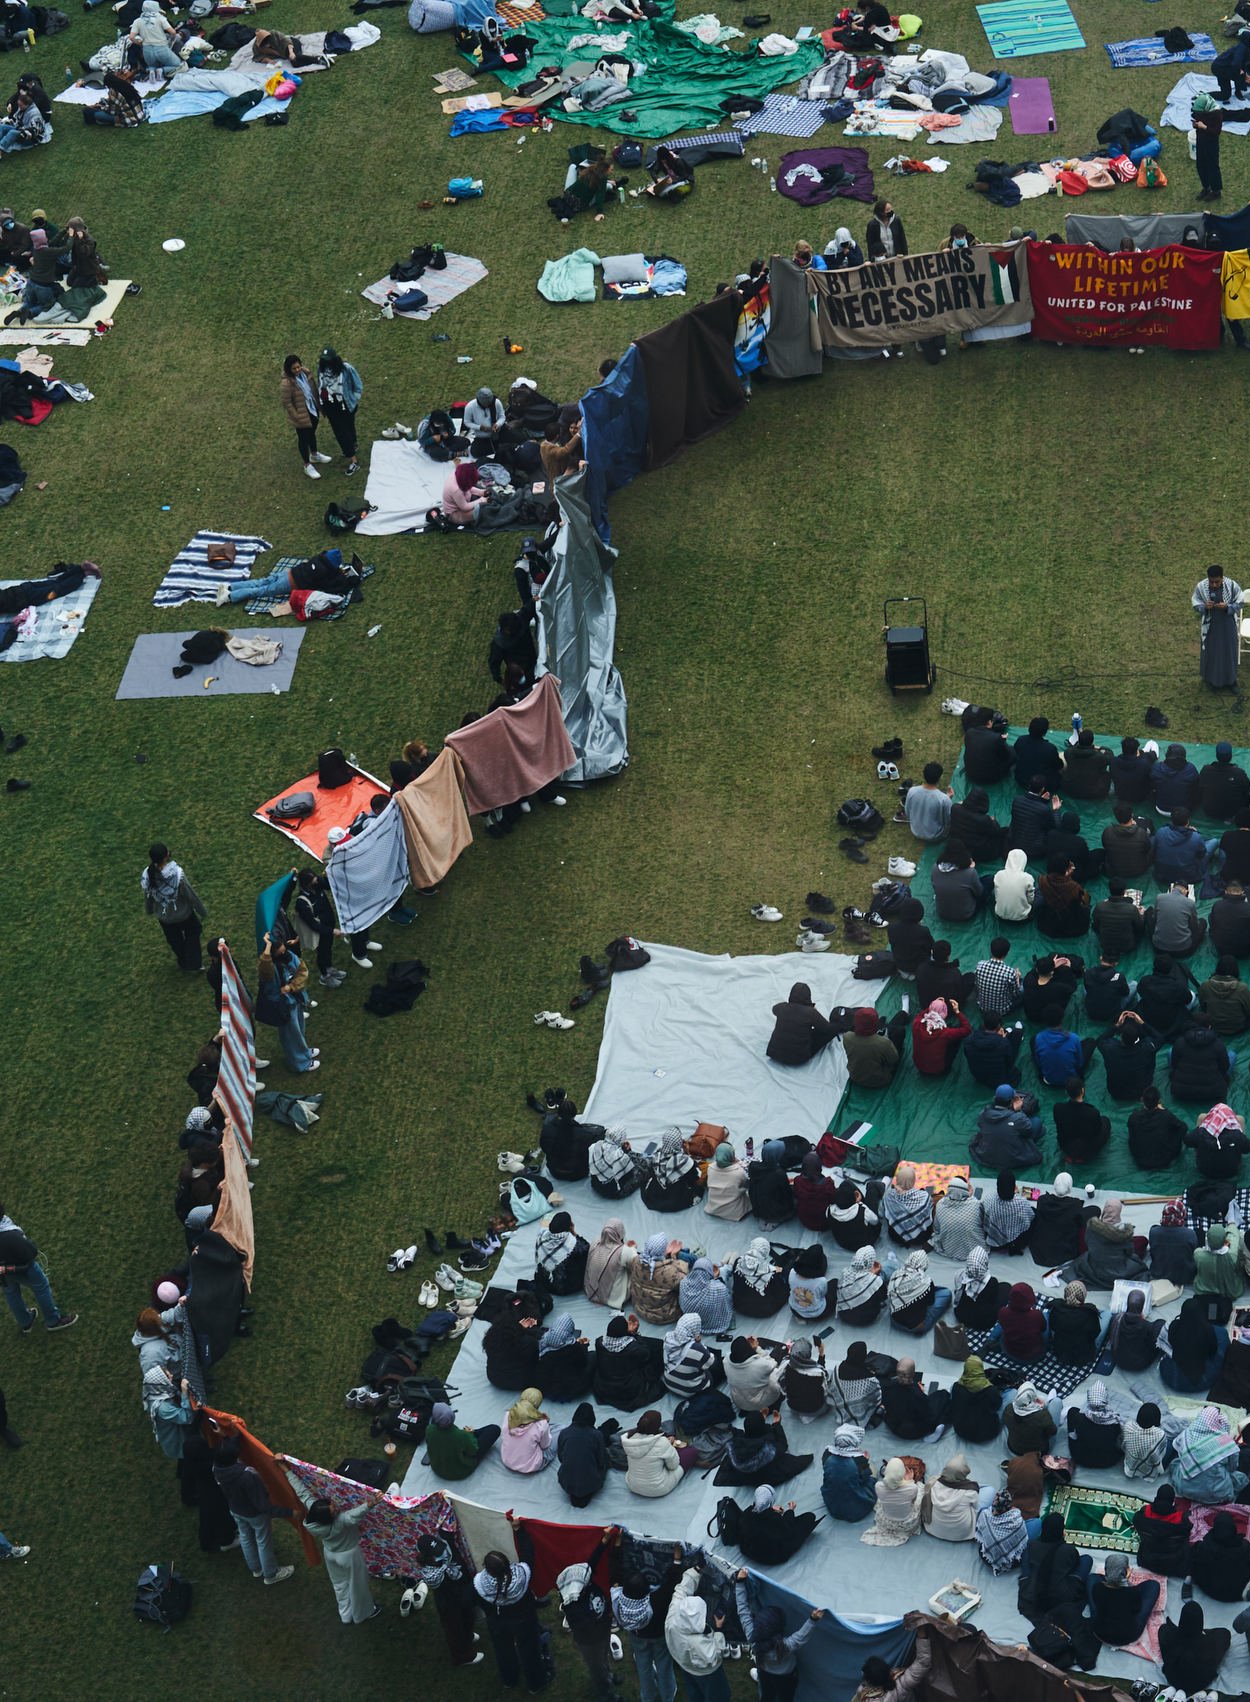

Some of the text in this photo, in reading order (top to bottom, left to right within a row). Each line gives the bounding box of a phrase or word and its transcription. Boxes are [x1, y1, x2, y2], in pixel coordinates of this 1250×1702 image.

[826, 248, 975, 295] BY ANY MEANS
[1055, 251, 1185, 275] WITHIN OUR
[1074, 274, 1169, 297] LIFETIME
[827, 274, 987, 328] NECESSARY
[1048, 297, 1193, 313] UNITED FOR PALESTINE
